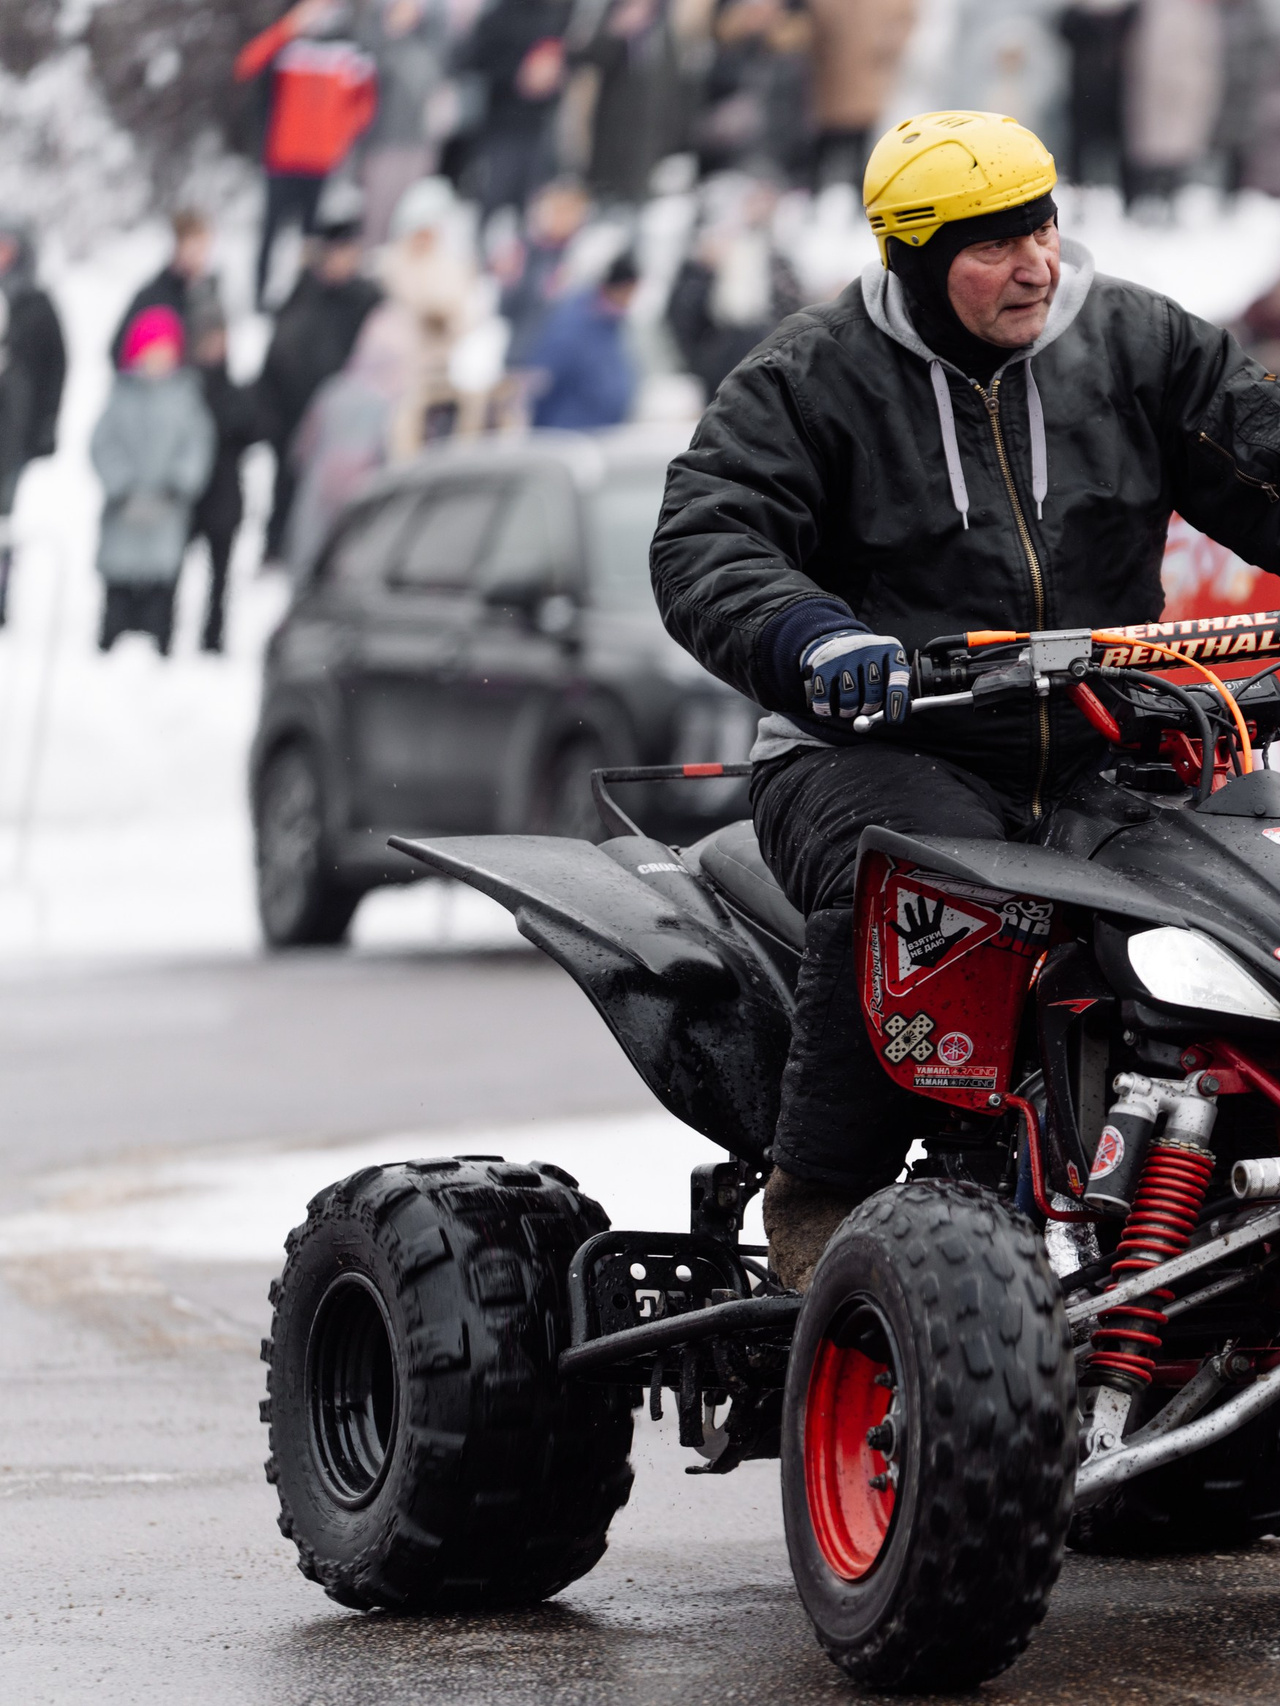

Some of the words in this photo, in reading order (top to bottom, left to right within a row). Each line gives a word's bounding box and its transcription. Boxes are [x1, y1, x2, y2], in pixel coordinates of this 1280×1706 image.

[1100, 629, 1280, 667] RENTHAL
[908, 931, 942, 950] ВЗЯТКИ
[910, 948, 923, 958] НЕ
[924, 938, 945, 953] ДАЮ
[870, 979, 884, 1017] Revs
[916, 1066, 950, 1075] YAMAHA
[960, 1067, 995, 1076] RACING
[915, 1078, 949, 1086] YAMAHA
[958, 1079, 993, 1087] RACING
